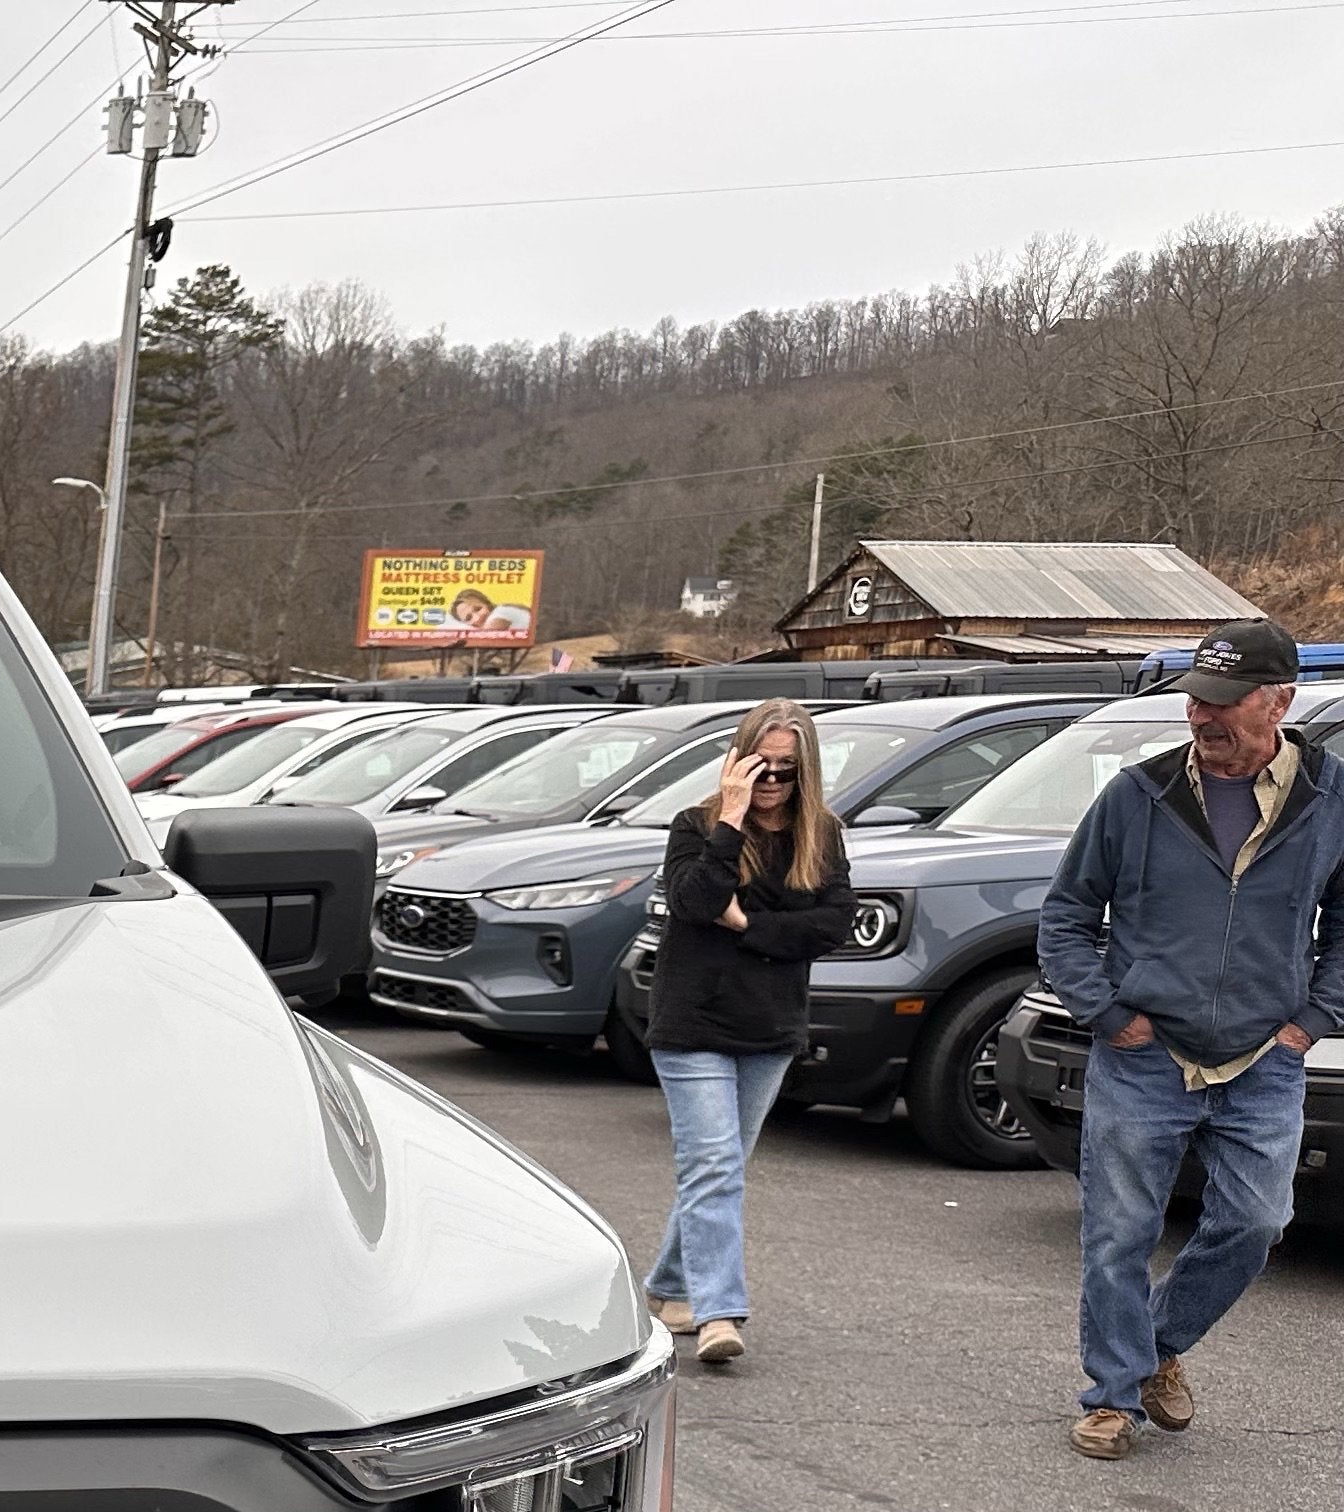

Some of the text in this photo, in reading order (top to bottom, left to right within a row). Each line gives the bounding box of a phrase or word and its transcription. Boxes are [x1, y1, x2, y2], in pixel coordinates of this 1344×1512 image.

[382, 560, 526, 571] NOTHING BUT BEDS
[381, 573, 524, 584] MATTRESS OUTLET
[381, 586, 443, 596] QUEEN SET
